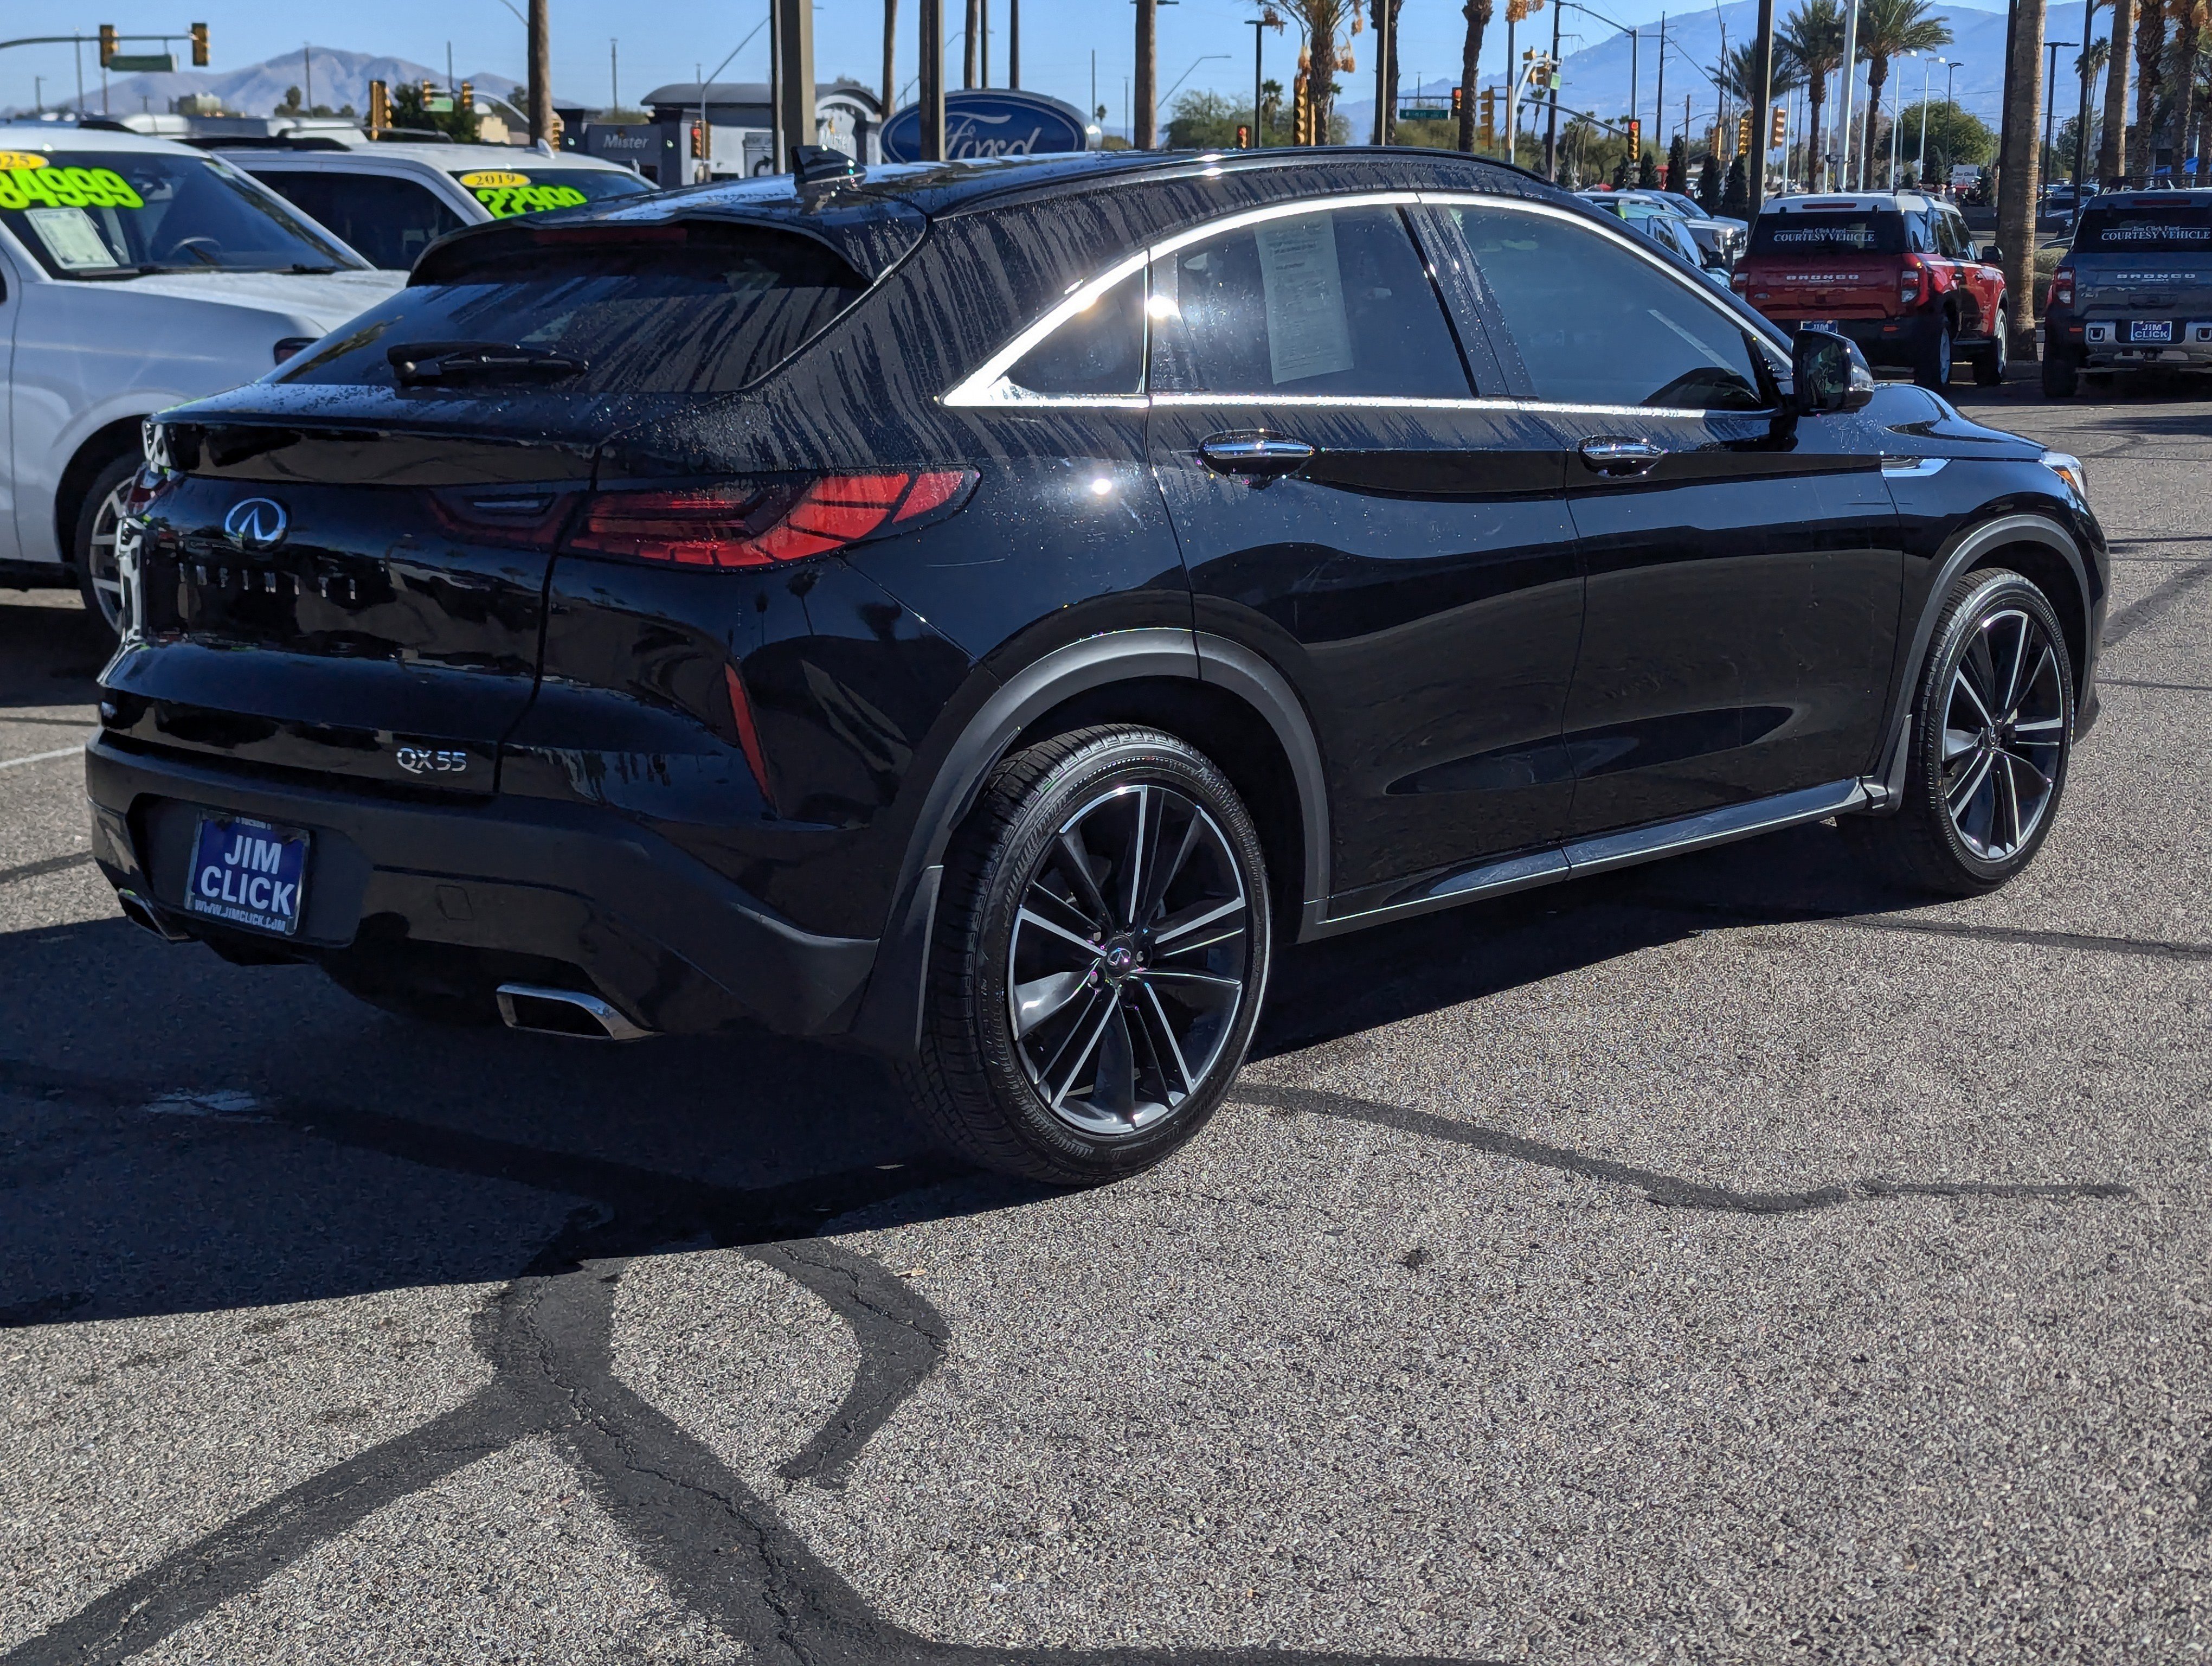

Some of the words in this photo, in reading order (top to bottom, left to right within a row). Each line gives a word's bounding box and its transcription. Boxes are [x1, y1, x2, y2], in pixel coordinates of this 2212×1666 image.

[603, 134, 649, 149] Mister
[946, 112, 1042, 161] Ford
[475, 174, 516, 185] 2019
[1774, 233, 1825, 241] COURTESY
[1828, 233, 1875, 241] VEHICLE
[2101, 232, 2158, 240] COURTESY
[2162, 231, 2210, 239] VEHICLE
[396, 748, 467, 774] QX55
[224, 835, 282, 874] JIM
[201, 866, 295, 915] CLICK
